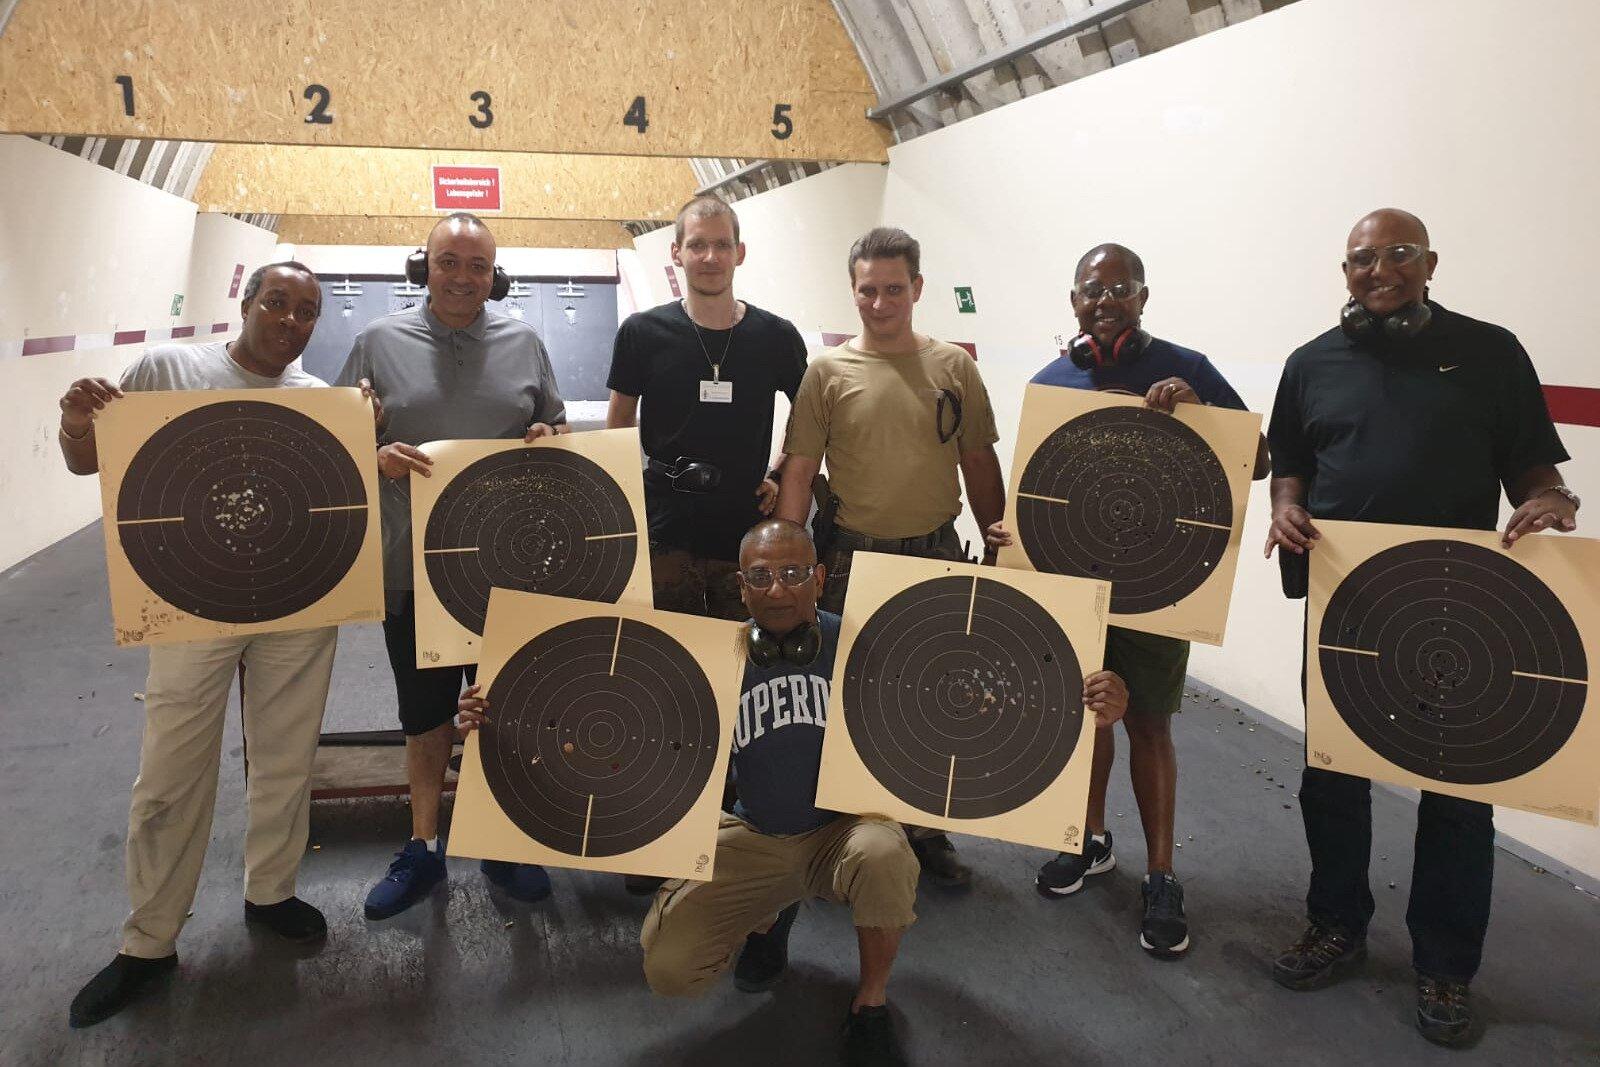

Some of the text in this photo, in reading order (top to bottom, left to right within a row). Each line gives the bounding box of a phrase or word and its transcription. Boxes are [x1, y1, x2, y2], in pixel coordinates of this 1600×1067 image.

[115, 75, 135, 117] 1
[303, 84, 333, 124] 2
[468, 90, 494, 129] 3
[623, 95, 649, 134] 4
[770, 104, 793, 140] 5
[732, 674, 832, 754] UPERD
